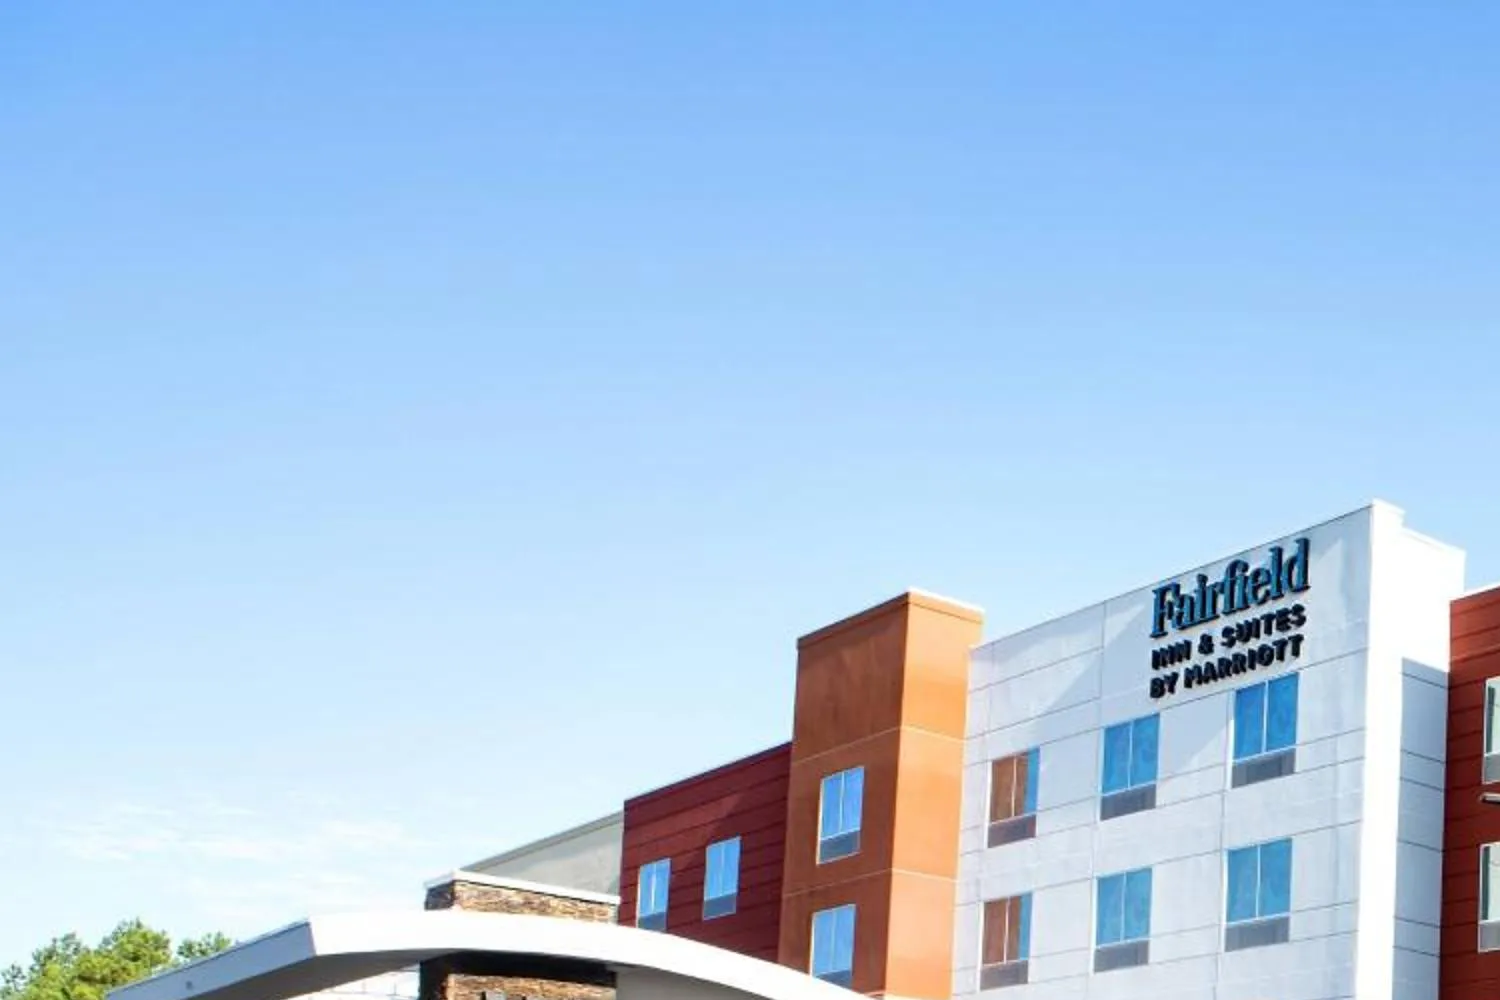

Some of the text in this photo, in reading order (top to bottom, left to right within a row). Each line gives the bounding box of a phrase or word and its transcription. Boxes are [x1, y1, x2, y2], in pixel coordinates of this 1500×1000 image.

[1149, 537, 1311, 638] Fairfield
[1149, 633, 1304, 699] BY MARRIOTT
[1151, 603, 1307, 671] INN & SUITES
